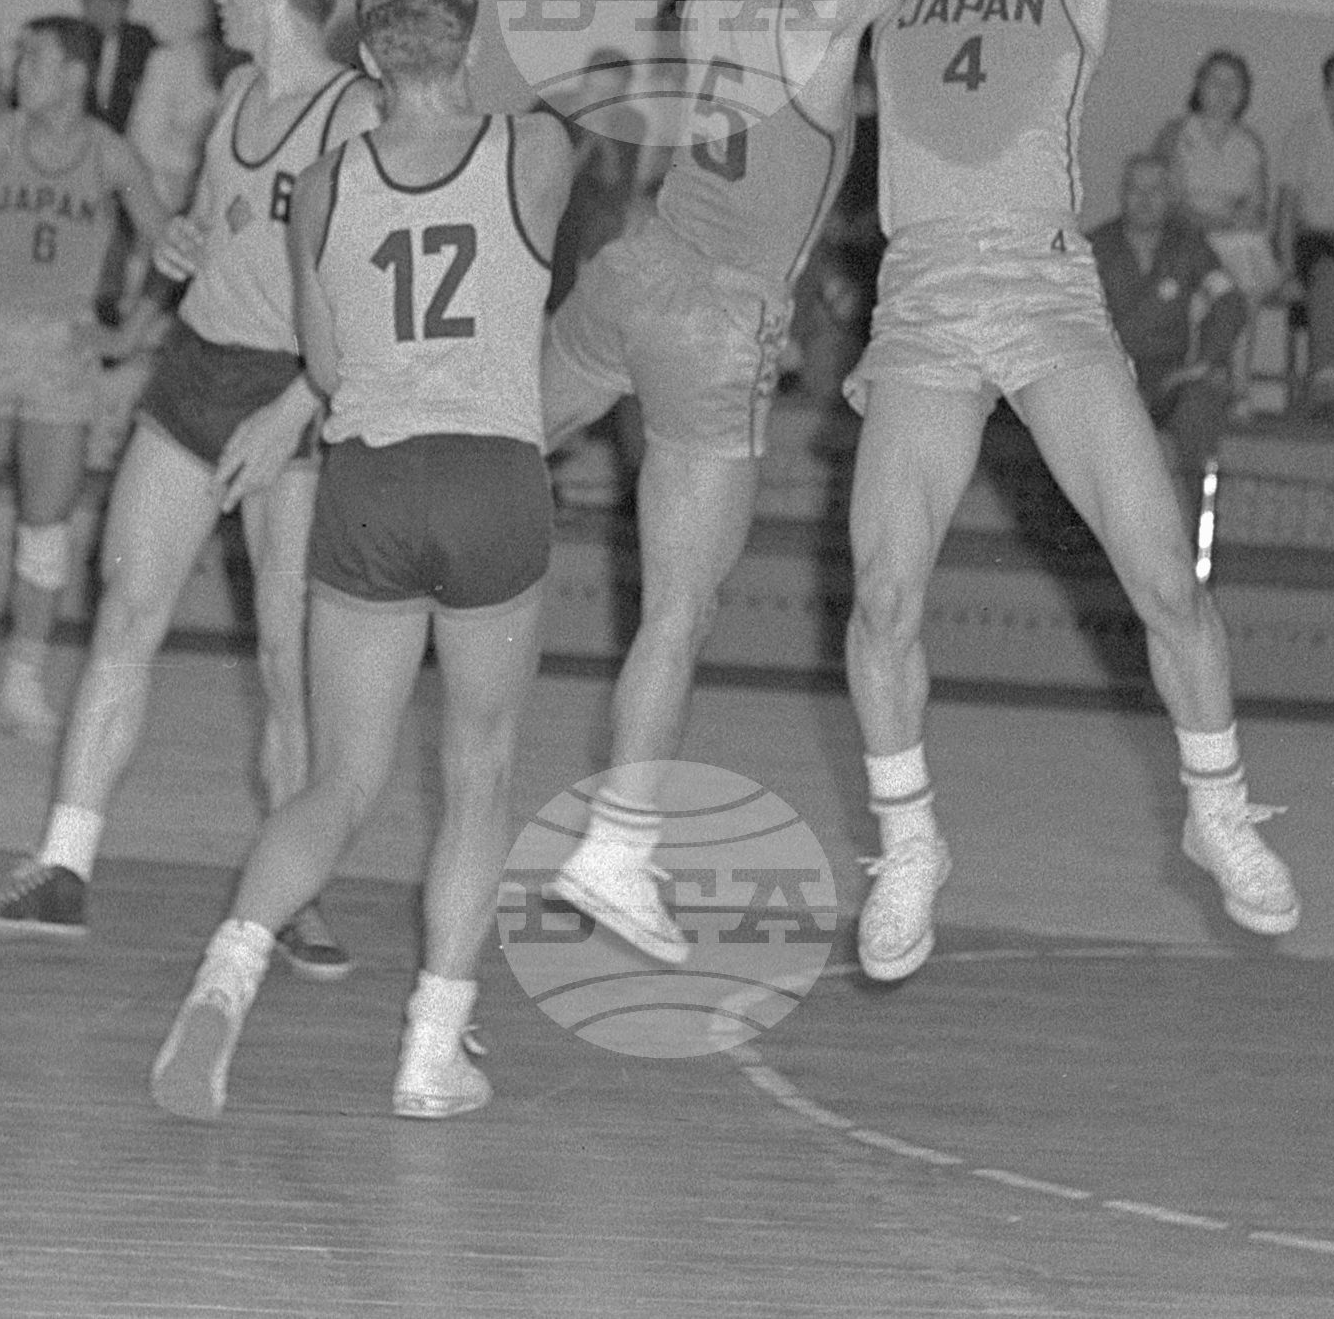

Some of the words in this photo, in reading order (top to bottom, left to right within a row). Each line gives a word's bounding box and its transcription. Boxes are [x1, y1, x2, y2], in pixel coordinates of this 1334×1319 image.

[943, 35, 987, 92] 4
[691, 55, 748, 182] 5
[33, 222, 57, 263] 6
[1050, 229, 1067, 253] 4
[370, 223, 476, 342] 12
